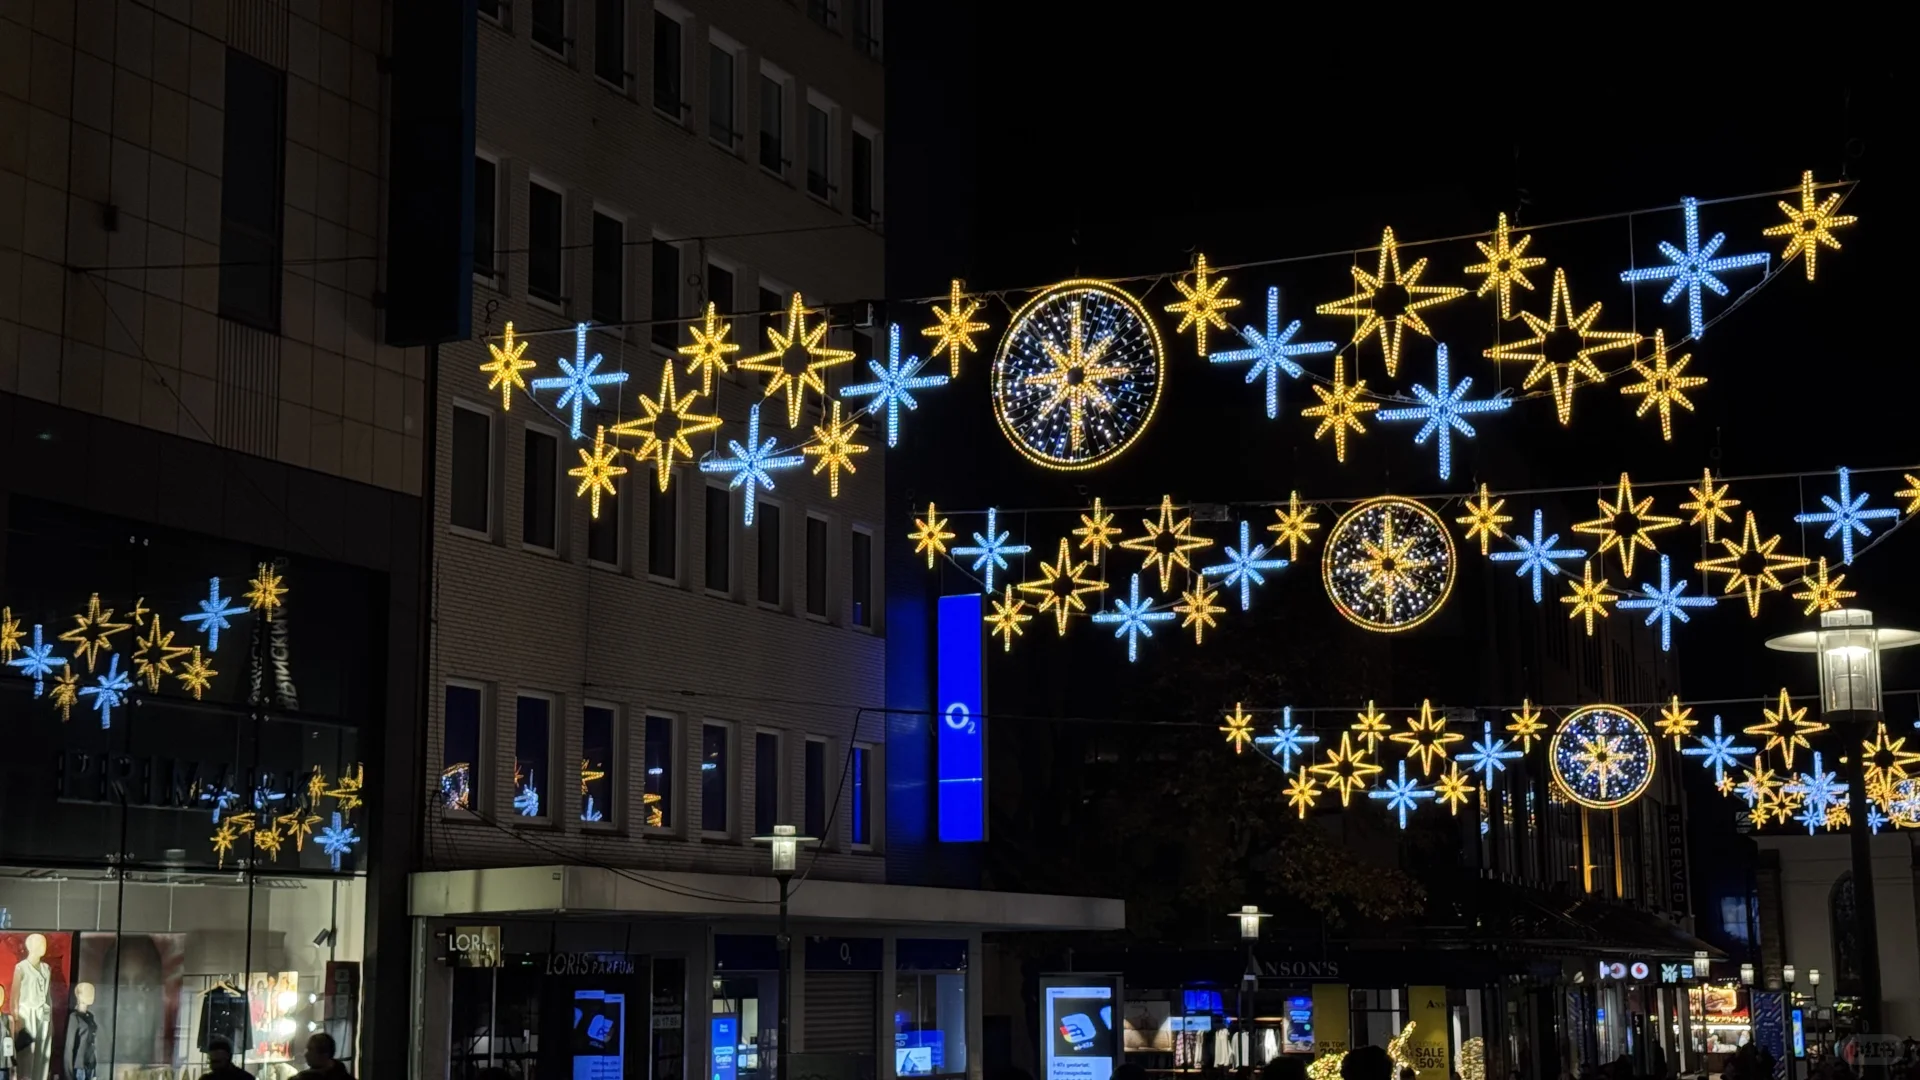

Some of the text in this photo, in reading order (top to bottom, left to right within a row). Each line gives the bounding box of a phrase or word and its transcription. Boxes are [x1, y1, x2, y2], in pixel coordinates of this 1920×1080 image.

[1668, 813, 1684, 904] RESERVED
[545, 953, 635, 976] LORIS PARFUM
[1661, 963, 1678, 983] WMF
[1416, 1048, 1444, 1057] SALE
